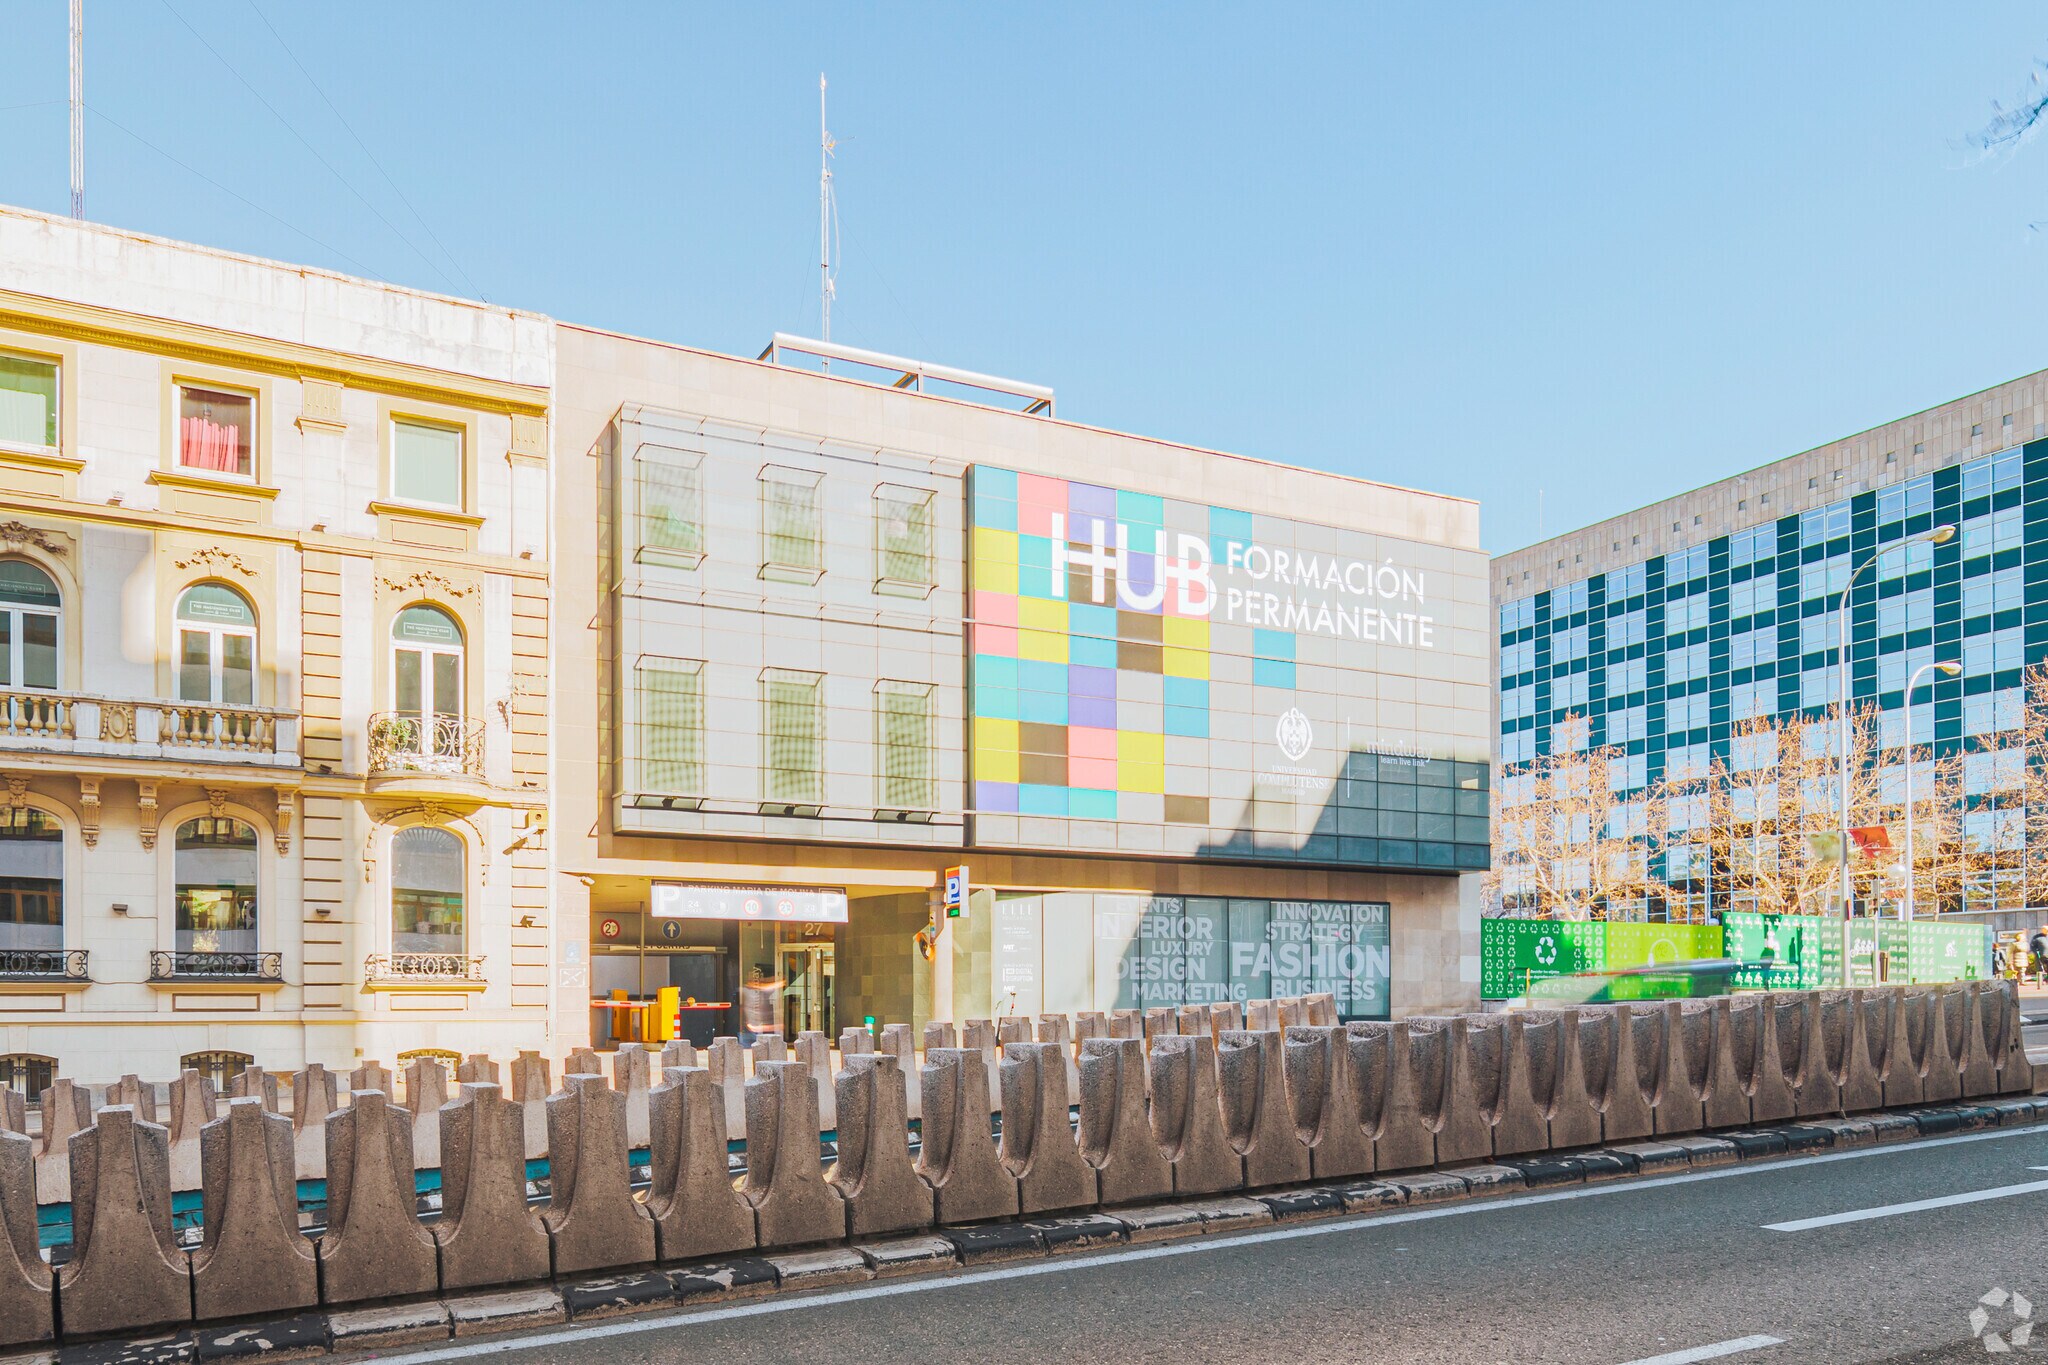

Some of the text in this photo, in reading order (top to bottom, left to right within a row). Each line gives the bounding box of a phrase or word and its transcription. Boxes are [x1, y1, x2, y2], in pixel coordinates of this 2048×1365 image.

[1051, 512, 1218, 616] HUB
[1227, 541, 1426, 605] FORMACIÓN
[1227, 587, 1434, 648] PERMANENTE
[1271, 764, 1317, 775] UNIVERSIDAD
[1380, 756, 1426, 768] learn live link
[688, 885, 815, 897] PARKING MARIA DE MOLINA
[947, 878, 959, 904] P
[1276, 903, 1384, 923] INNOVATION
[805, 923, 823, 936] 27
[1095, 914, 1214, 940] INERIOR
[1265, 921, 1364, 942] STRATEGY
[1151, 940, 1214, 956] LUXURY
[1112, 956, 1206, 981] DESIGN
[1232, 942, 1389, 978] FASHION
[1132, 983, 1247, 1001] MARKETING
[1271, 980, 1376, 1001] BUSINESS
